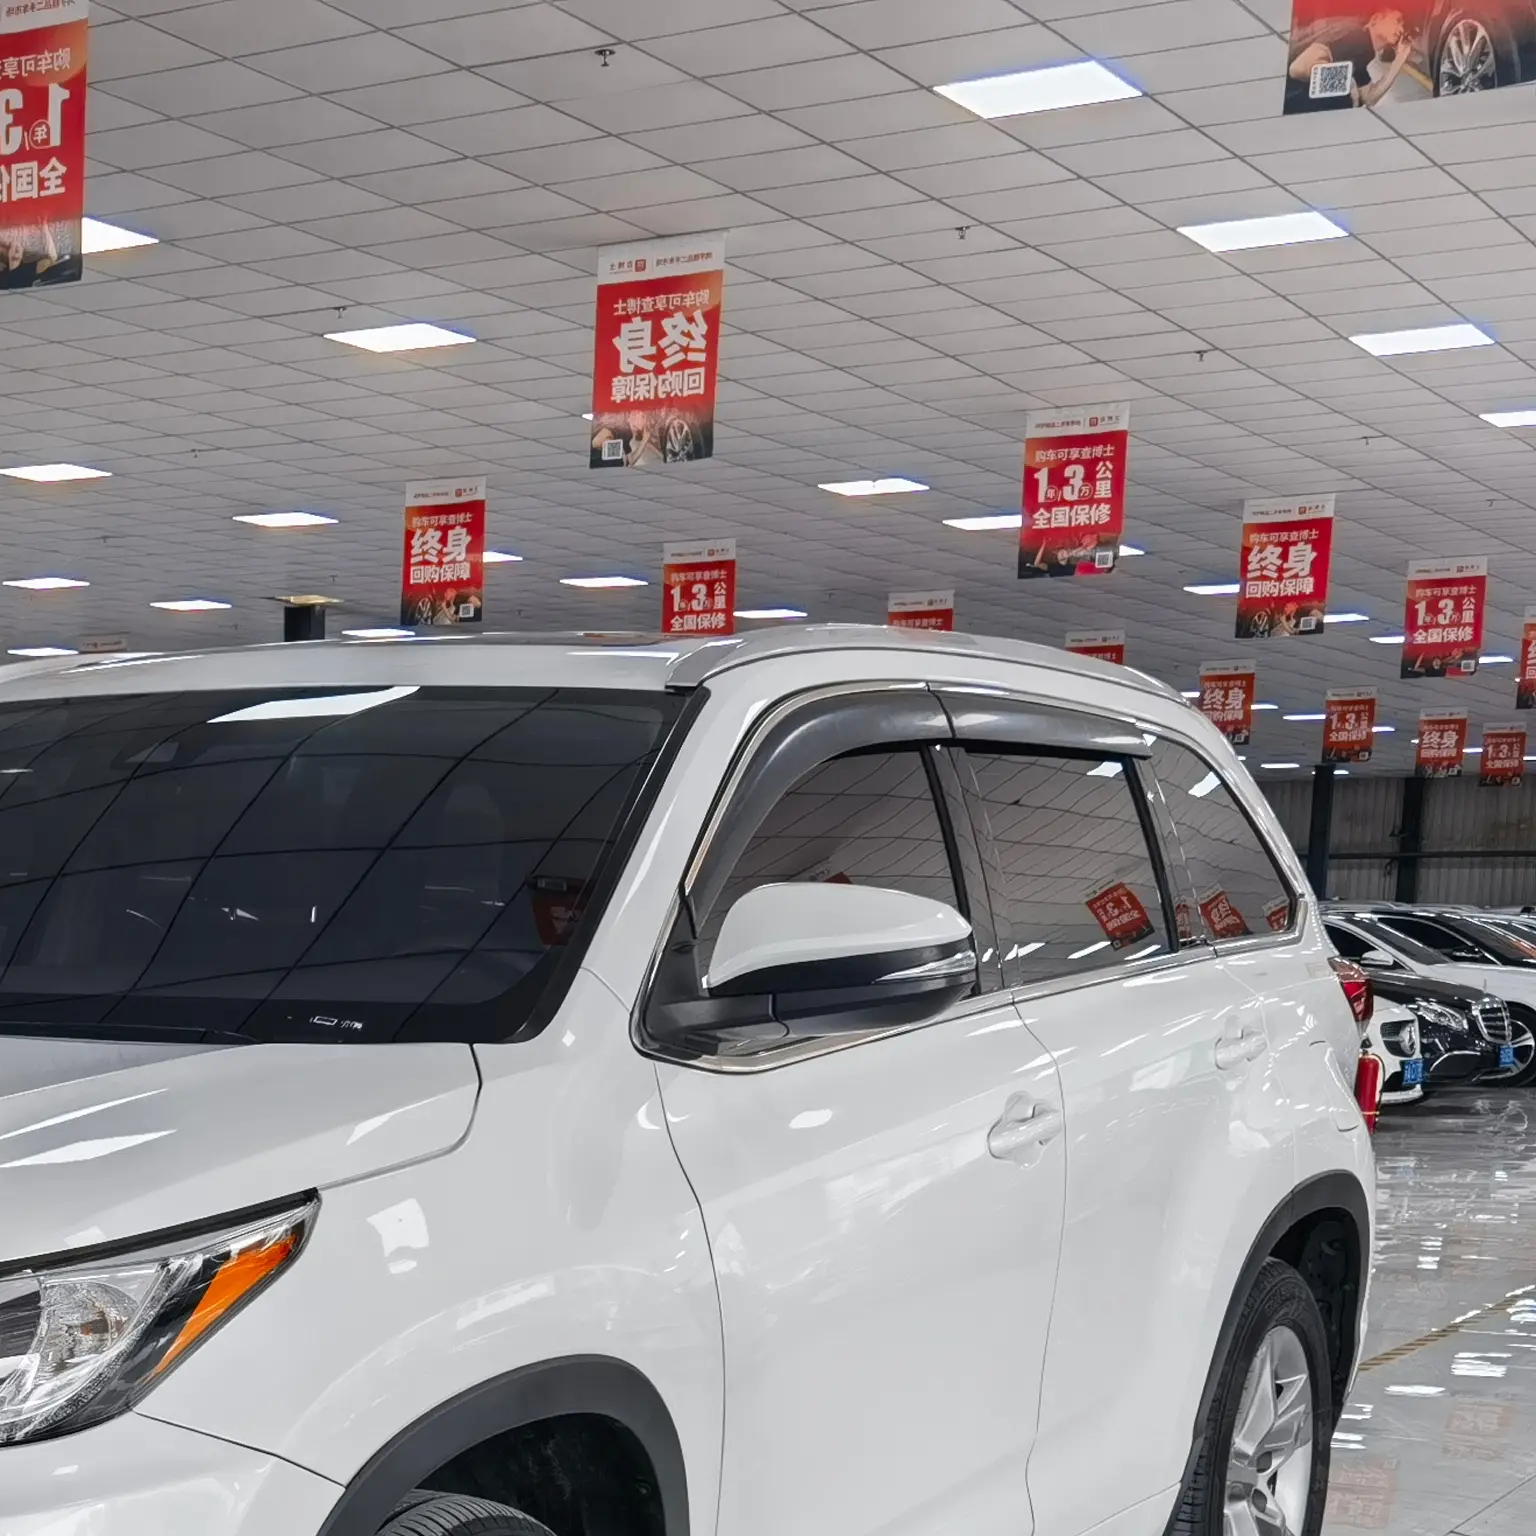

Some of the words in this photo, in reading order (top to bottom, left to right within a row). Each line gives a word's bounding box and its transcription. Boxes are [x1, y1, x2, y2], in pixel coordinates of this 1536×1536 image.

[1032, 503, 1111, 529] 全国保修
[410, 525, 472, 565] 终身
[1247, 541, 1318, 579] 终身
[410, 562, 471, 584] 回购保障
[1245, 576, 1314, 599] 回购保障
[1413, 626, 1473, 644] 全国保修
[1203, 687, 1246, 709] 终身
[1421, 731, 1459, 749] 终身
